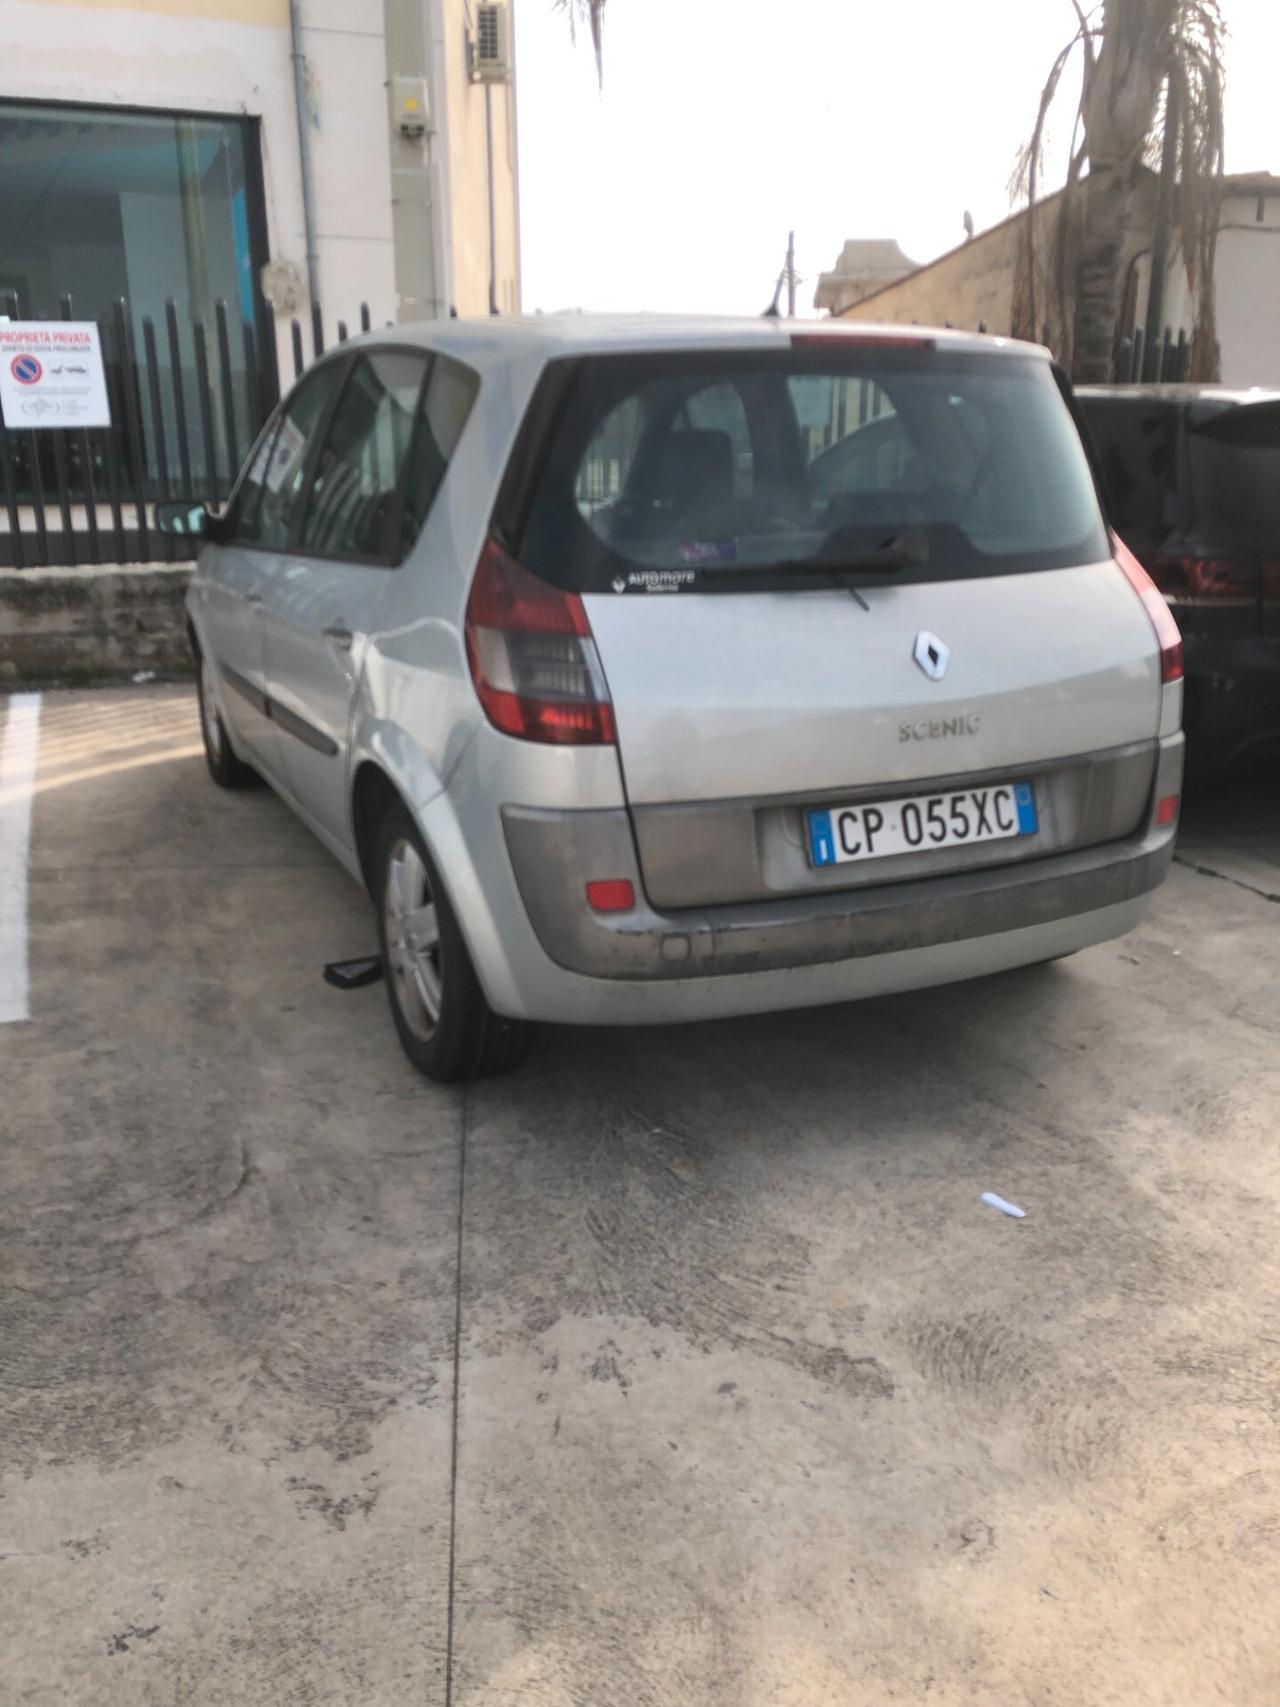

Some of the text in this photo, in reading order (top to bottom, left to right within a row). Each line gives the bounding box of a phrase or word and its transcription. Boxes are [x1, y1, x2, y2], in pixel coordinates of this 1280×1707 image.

[52, 331, 91, 344] PRIVATA
[897, 715, 982, 743] SCENIC
[837, 788, 1014, 856] CP 055XC
